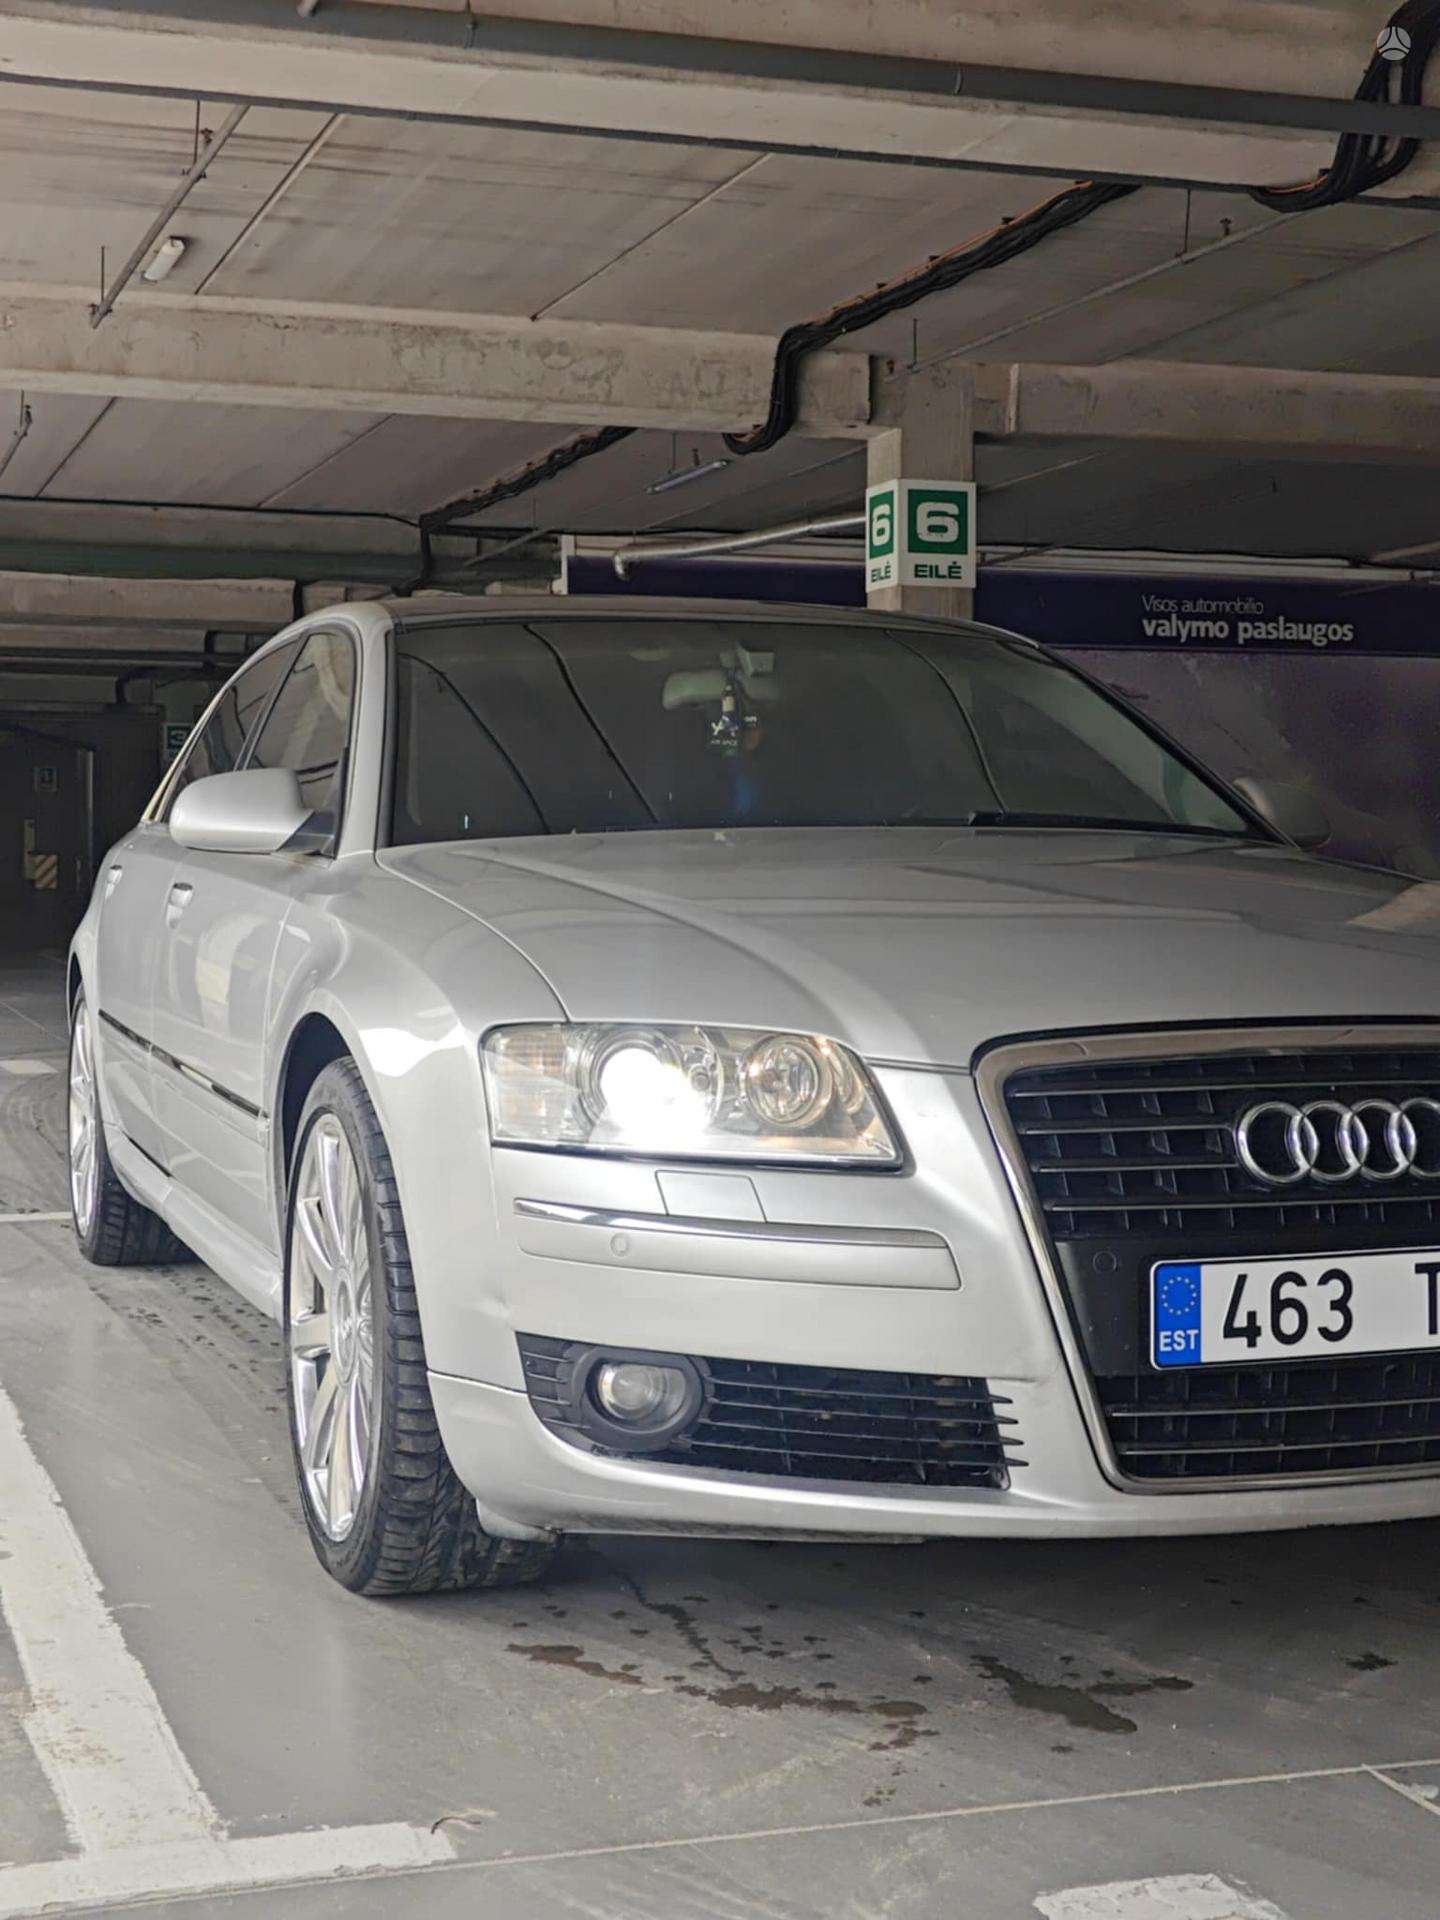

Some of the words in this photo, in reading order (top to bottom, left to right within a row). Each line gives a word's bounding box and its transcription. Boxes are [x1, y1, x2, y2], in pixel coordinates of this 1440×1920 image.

[872, 503, 891, 547] 6
[916, 501, 960, 543] 6
[1142, 595, 1178, 613] Visos
[1142, 614, 1229, 643] valymo
[1238, 616, 1354, 646] paslaugos
[1223, 1268, 1354, 1348] 463
[1415, 1263, 1440, 1335] T
[1159, 1329, 1199, 1352] EST
